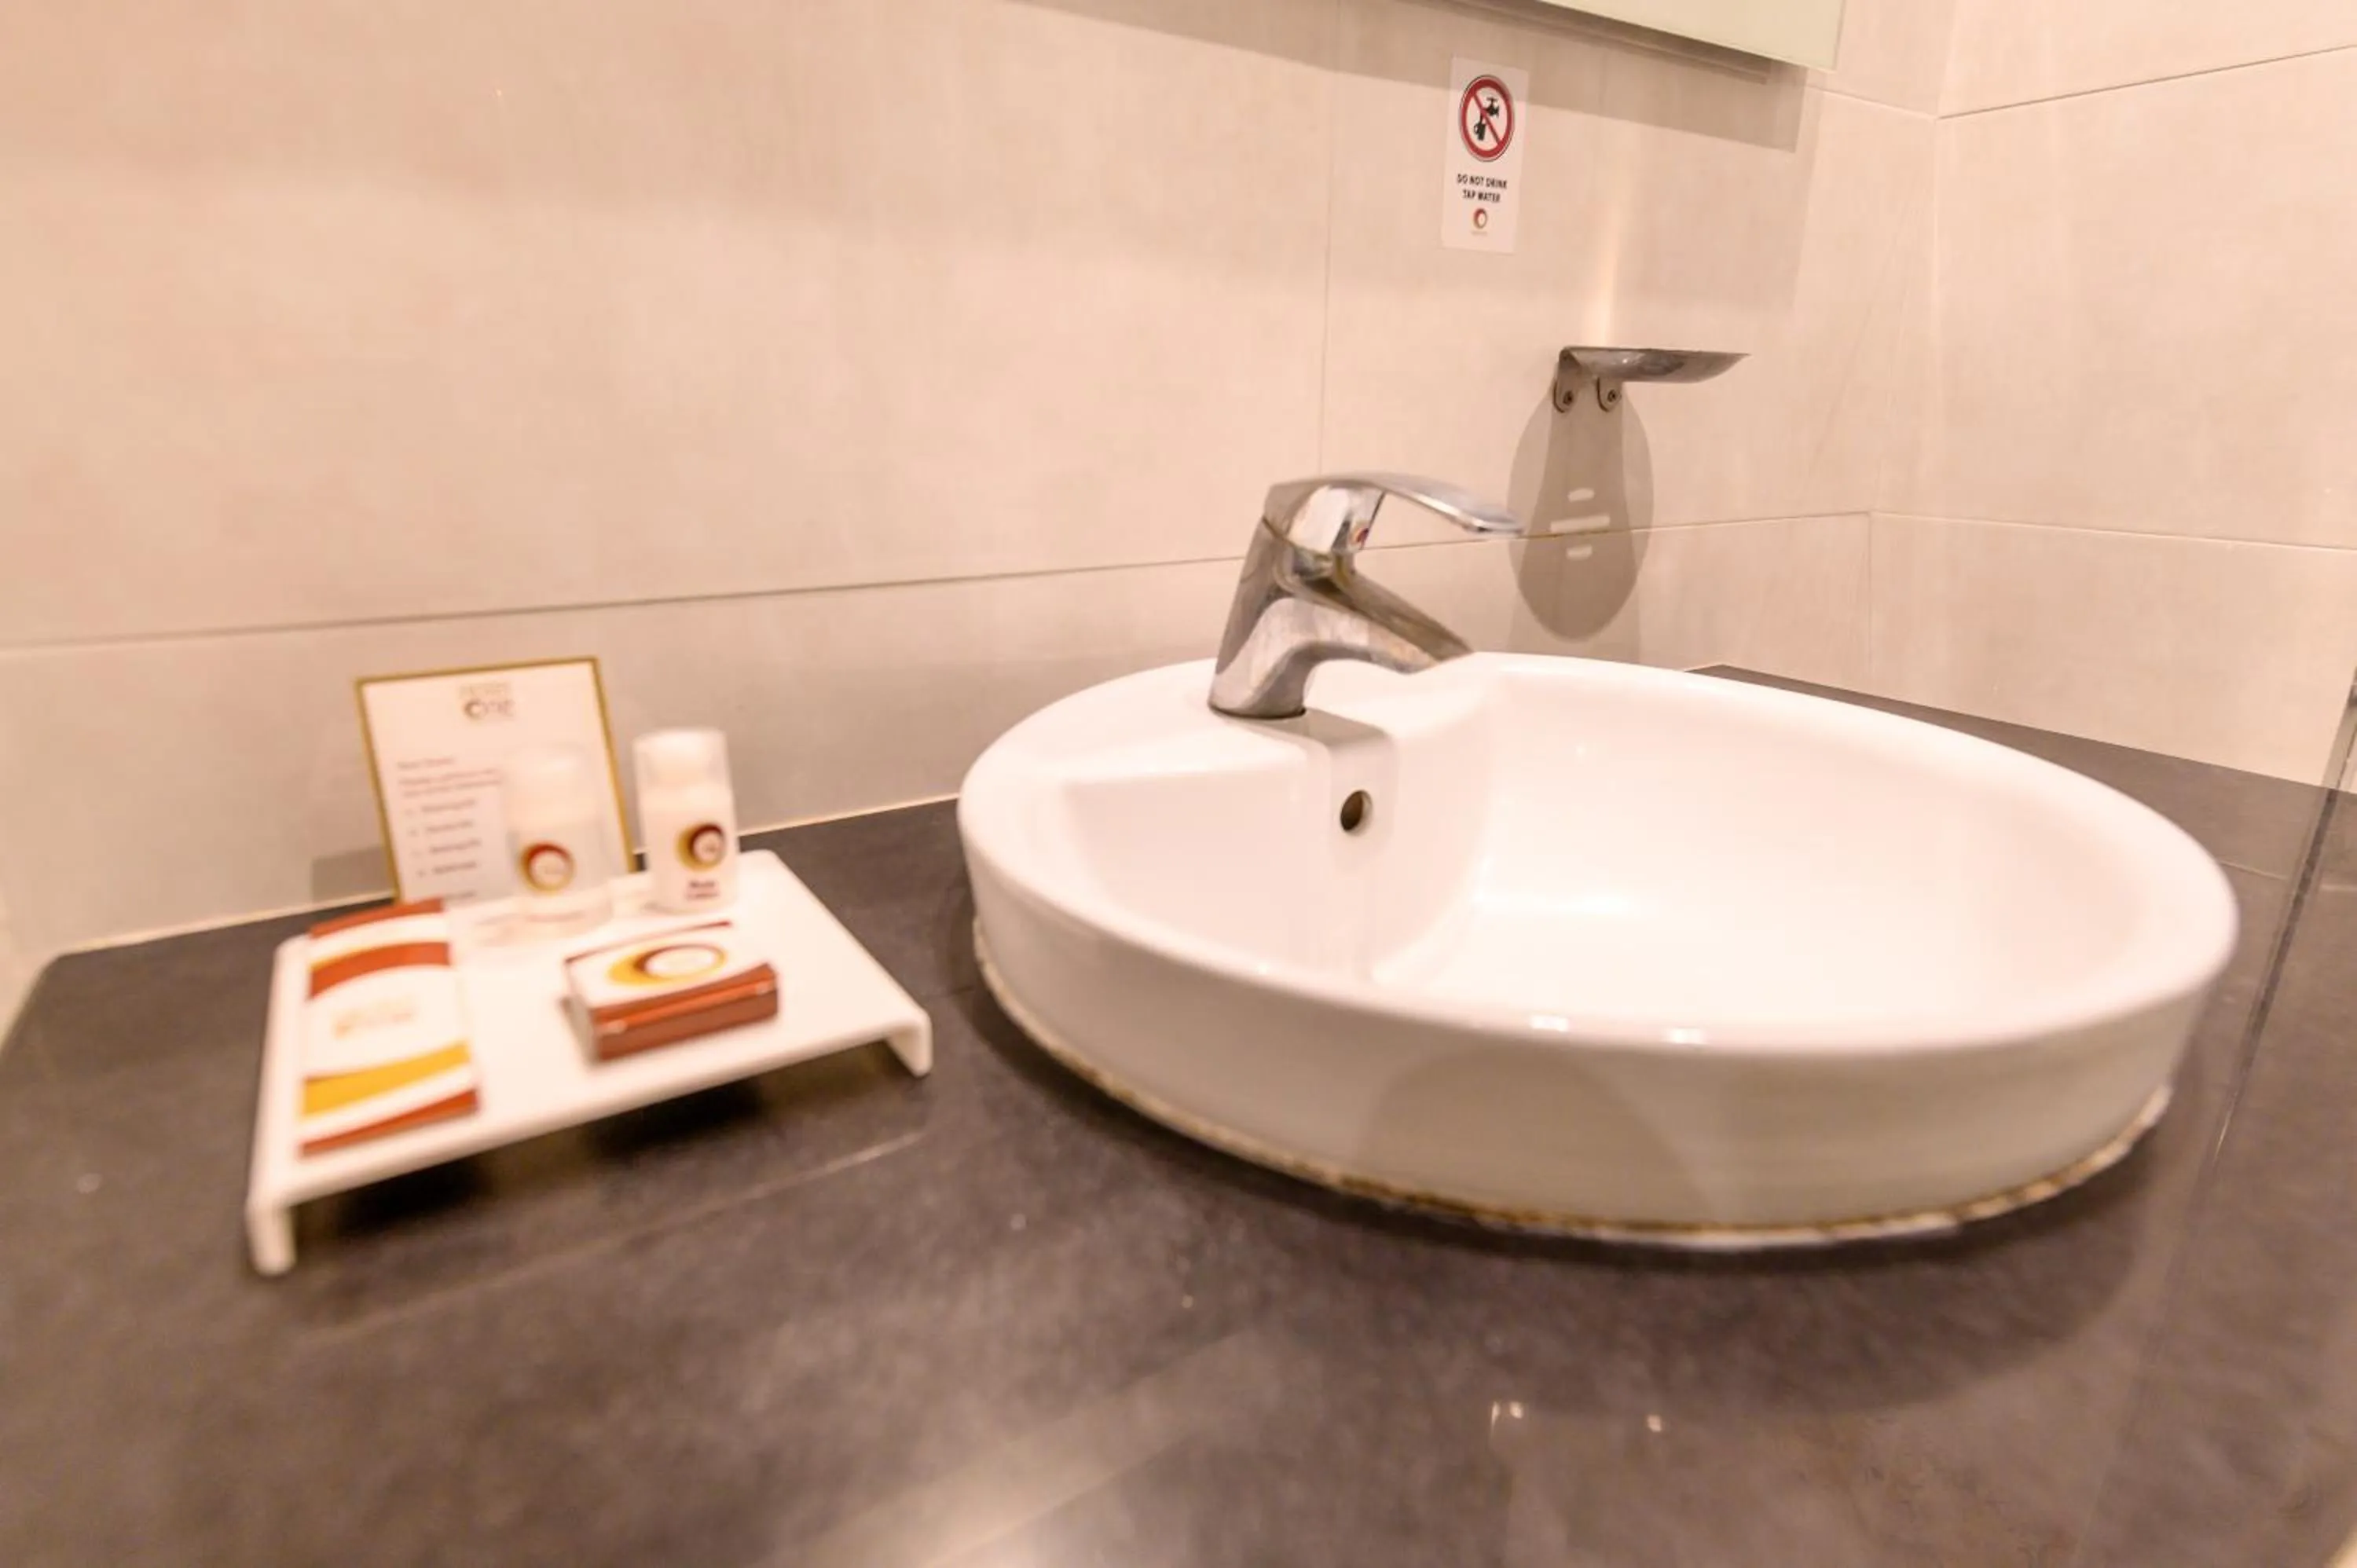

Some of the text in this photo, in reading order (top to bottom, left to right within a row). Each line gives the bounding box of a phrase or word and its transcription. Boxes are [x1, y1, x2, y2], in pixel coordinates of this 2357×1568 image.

[1457, 174, 1508, 189] DO NOT DRINK
[1462, 189, 1501, 203] TAP WATER
